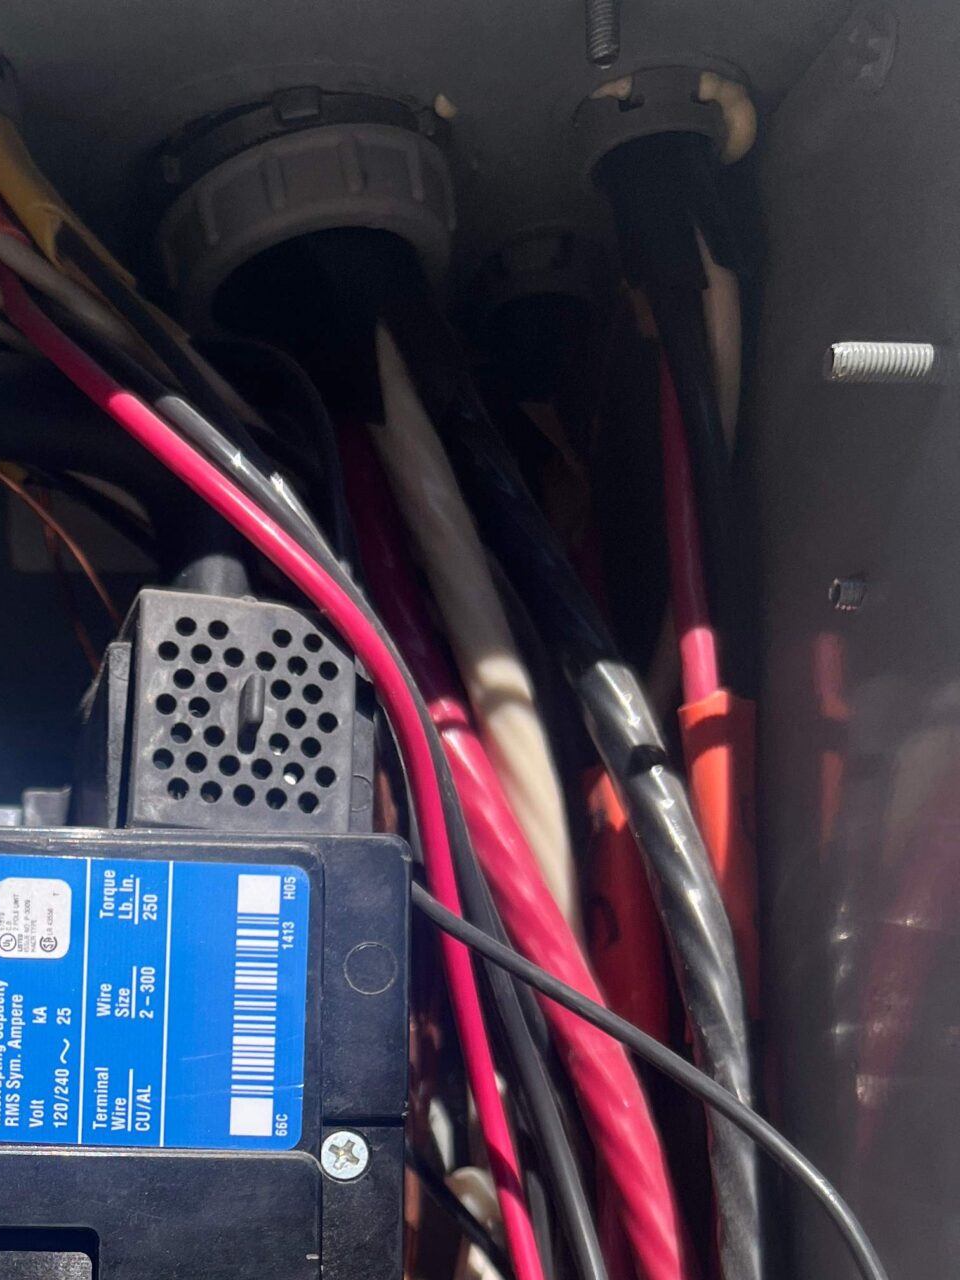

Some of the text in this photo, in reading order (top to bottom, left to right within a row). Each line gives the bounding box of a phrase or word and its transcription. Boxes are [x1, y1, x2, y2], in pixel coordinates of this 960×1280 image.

[100, 869, 117, 919] Torque
[118, 875, 133, 919] Lb. In.
[283, 876, 297, 900] H05
[143, 895, 157, 920] 250
[282, 921, 295, 949] 1413
[33, 1007, 47, 1023] kA
[97, 984, 112, 1016] Wire
[115, 988, 130, 1017] Size
[56, 1008, 71, 1024] 25
[5, 994, 24, 1126] RMS Sym. Ampere
[53, 1069, 69, 1127] 120/240
[93, 1067, 108, 1129] Terminal
[135, 1086, 151, 1131] CU/AL
[29, 1100, 44, 1127] Volt
[111, 1098, 127, 1130] Wire
[275, 1113, 288, 1136] 66C
